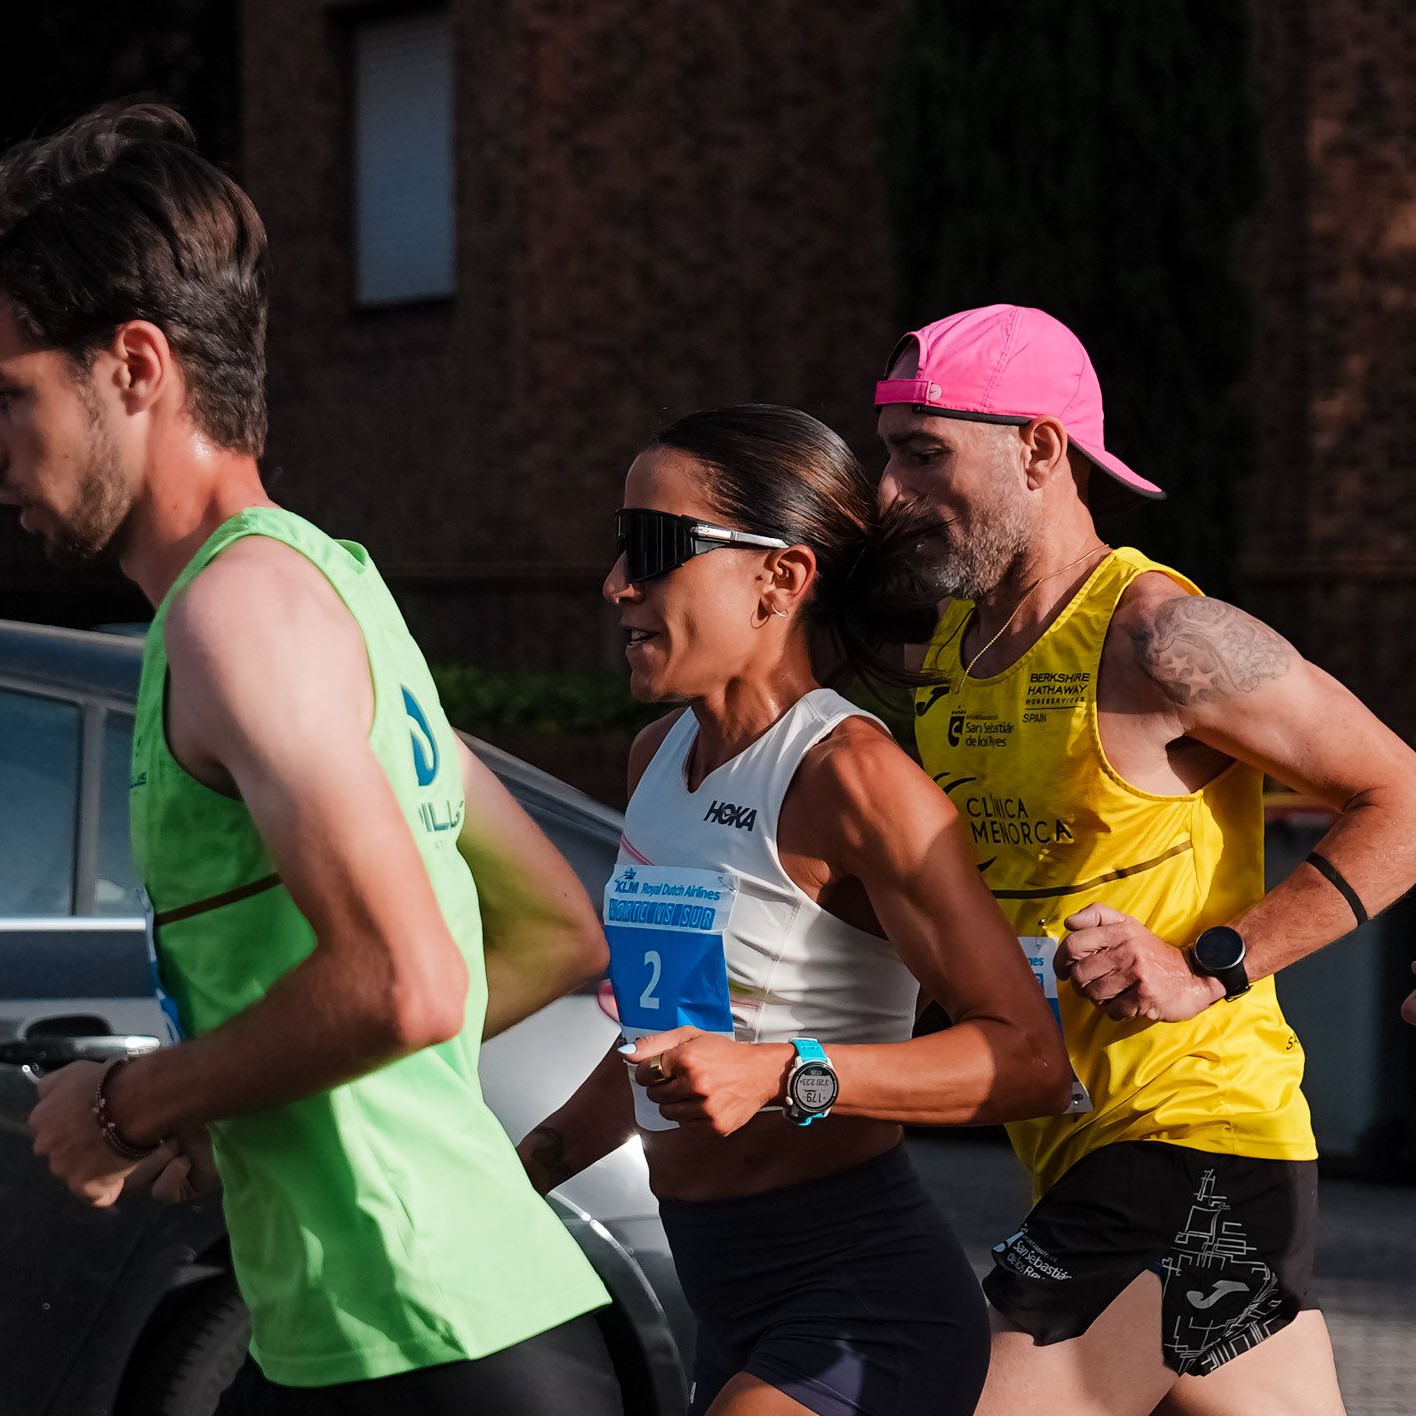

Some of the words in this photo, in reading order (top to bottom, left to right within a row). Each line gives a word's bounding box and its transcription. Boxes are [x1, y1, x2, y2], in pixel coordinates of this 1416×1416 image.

[1030, 672, 1091, 683] BERKSHIRE
[1027, 684, 1088, 695] HATHAWAY
[1022, 713, 1047, 723] SPAIN
[703, 800, 758, 831] HOKA
[970, 819, 1073, 845] MENORCA
[641, 883, 663, 897] Royal
[662, 884, 684, 896] Dutch
[684, 884, 721, 900] Airlines
[609, 900, 648, 922] NORTE
[655, 904, 675, 924] VS
[682, 906, 715, 929] SUR
[639, 950, 663, 1010] 2
